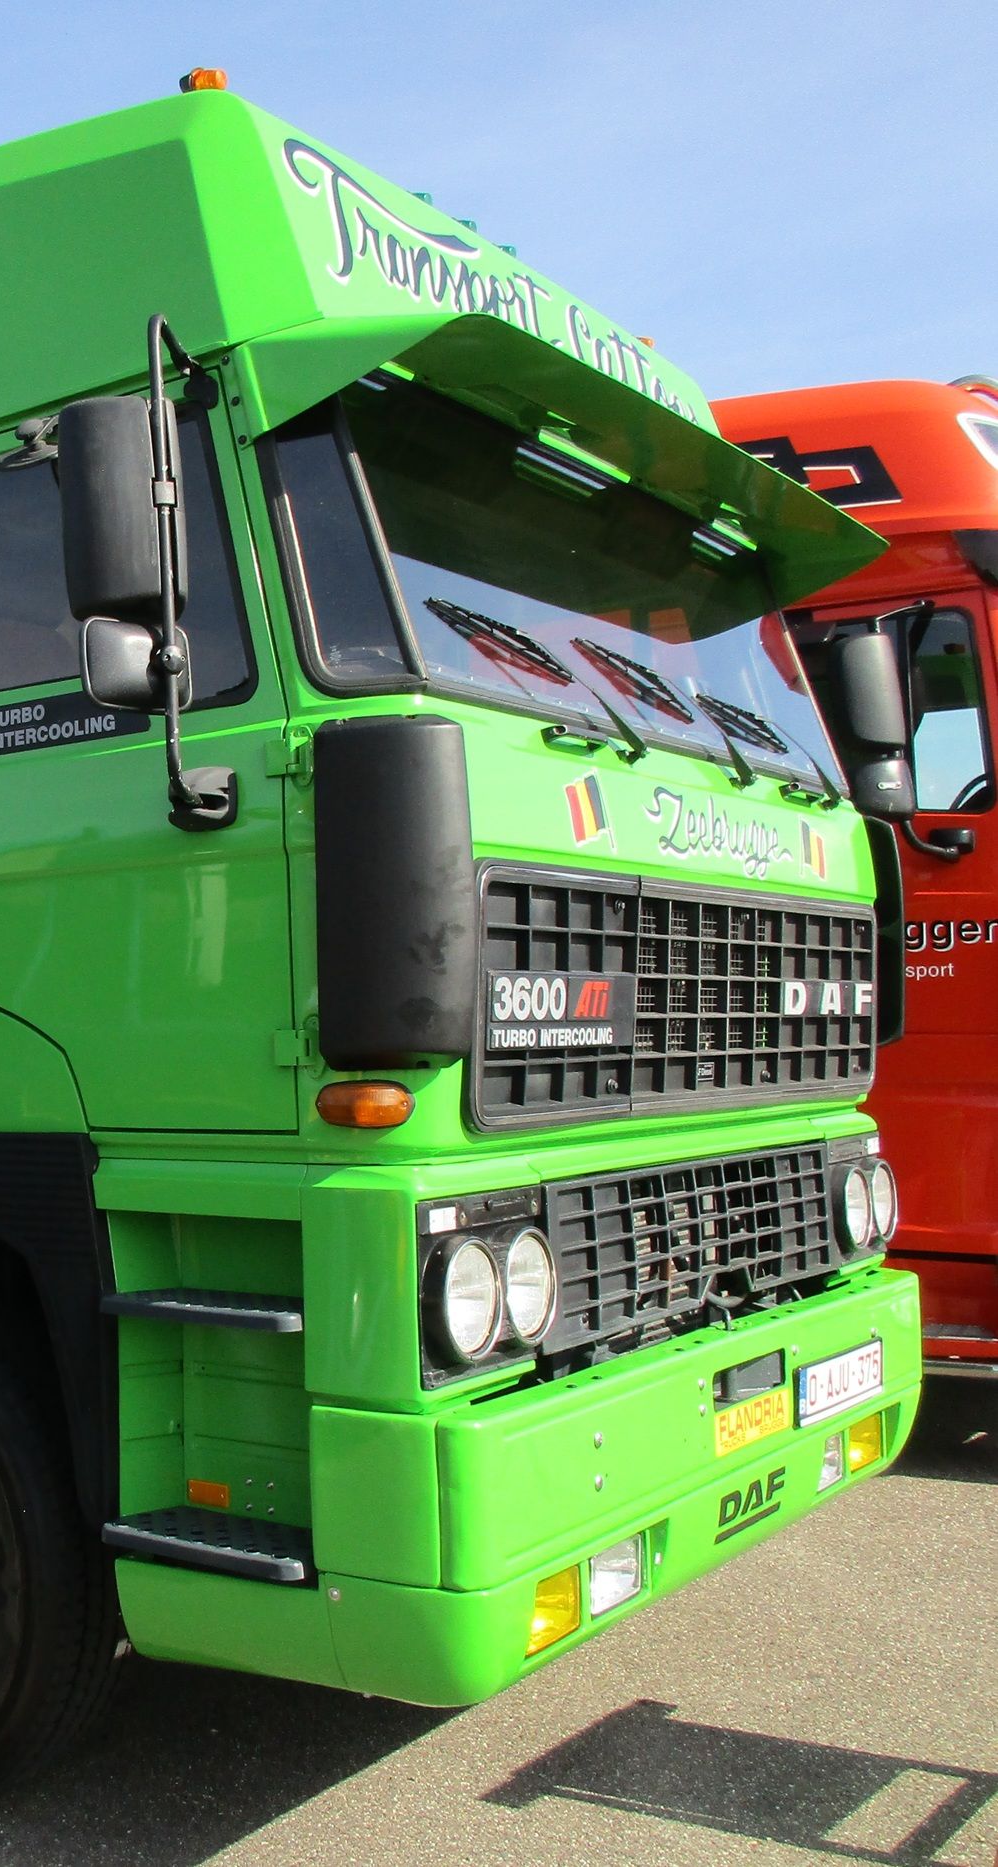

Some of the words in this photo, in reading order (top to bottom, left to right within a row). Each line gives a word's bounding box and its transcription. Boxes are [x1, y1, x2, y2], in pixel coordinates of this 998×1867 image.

[282, 138, 552, 338] Transport
[643, 785, 793, 880] Zeebrugge
[493, 976, 567, 1021] 3600
[492, 1028, 537, 1048] TURBO
[539, 1026, 614, 1048] INTERCOOLING
[719, 1393, 785, 1440] FLANDRIA
[718, 1466, 786, 1527] DAF
